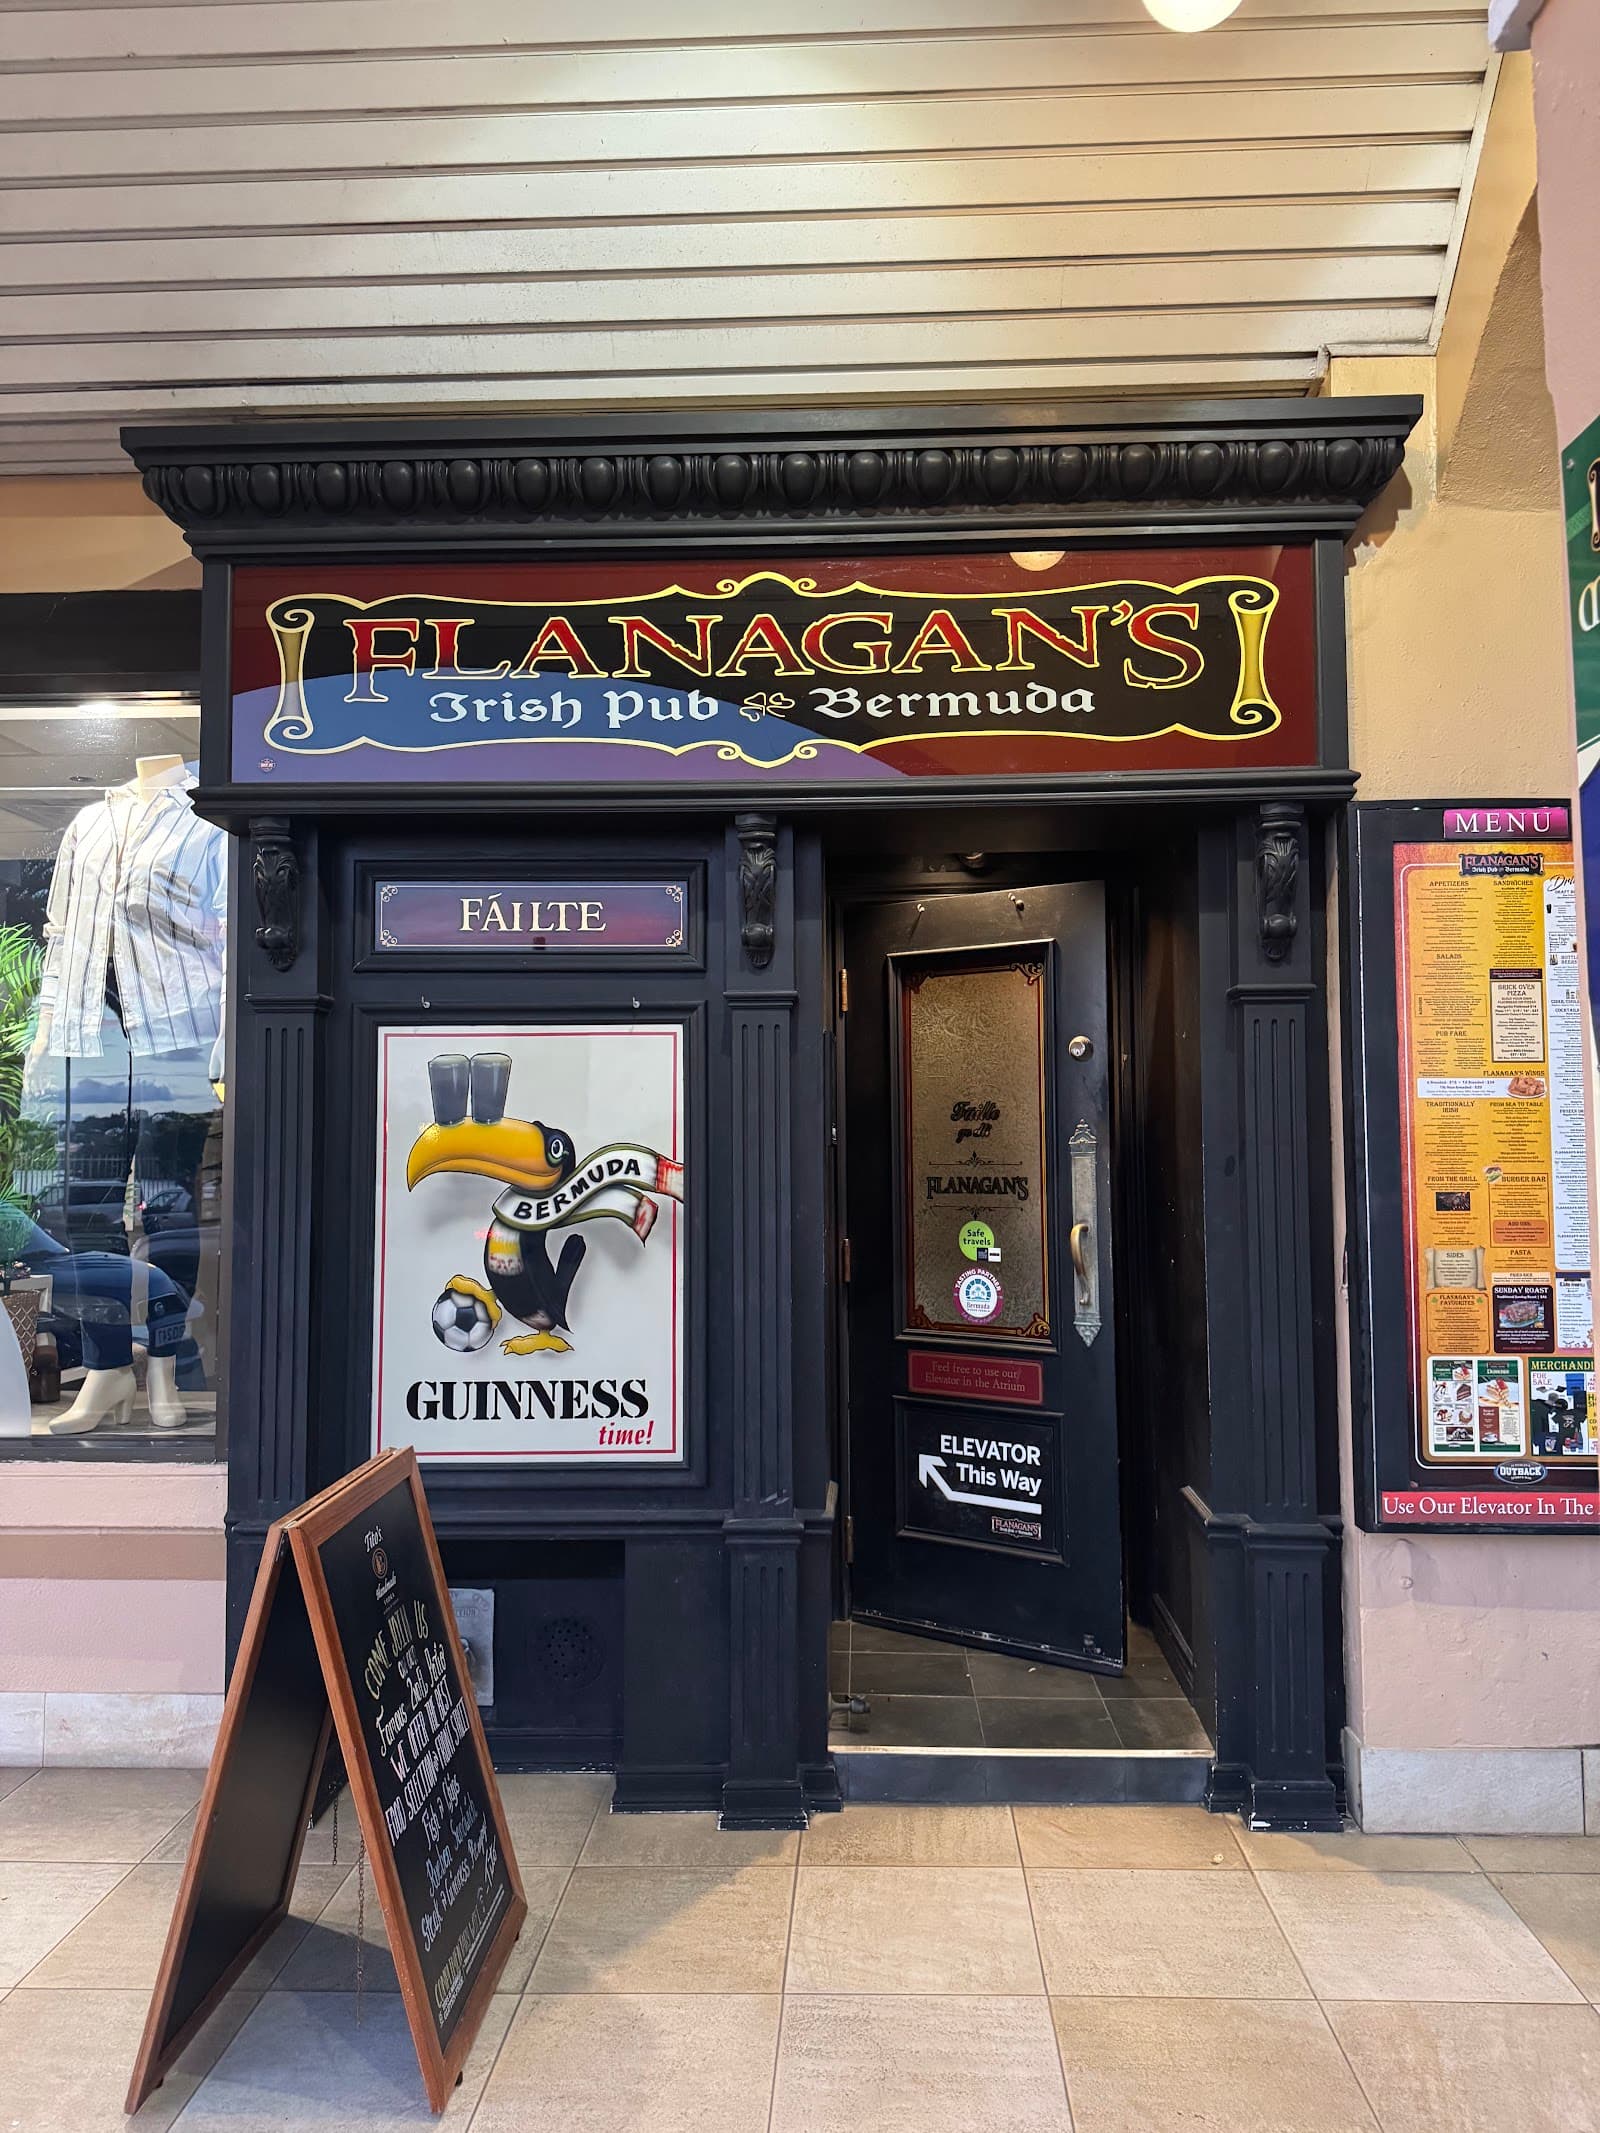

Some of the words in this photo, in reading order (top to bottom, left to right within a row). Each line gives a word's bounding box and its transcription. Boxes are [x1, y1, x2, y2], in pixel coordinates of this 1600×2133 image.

[343, 603, 1204, 703] FLANAGAN'S
[430, 690, 582, 730] Irish
[603, 689, 719, 729] Pub
[809, 682, 1096, 719] Bermuda
[1455, 812, 1552, 833] MENU
[1464, 854, 1539, 869] FLANAGAN'S
[459, 892, 608, 932] FÁILTE
[513, 1158, 642, 1221] BERMUDA
[926, 1176, 1029, 1200] FLANAGAN'S
[963, 1237, 991, 1246] travels
[967, 1229, 985, 1237] Safe
[955, 1269, 977, 1289] TASTING
[977, 1268, 1002, 1291] PARTNER
[1494, 1286, 1524, 1294] SUNDAY
[925, 1372, 959, 1385] Elevator
[975, 1377, 990, 1388] the
[992, 1379, 1026, 1393] Atrium
[932, 1361, 950, 1372] Feel
[953, 1362, 970, 1374] free
[972, 1367, 982, 1376] to
[984, 1368, 1000, 1377] use
[406, 1379, 650, 1420] GUINNESS
[599, 1420, 655, 1446] time!
[940, 1434, 1041, 1466] ELEVATOR
[956, 1462, 997, 1486] This
[1000, 1469, 1042, 1497] Way
[1500, 1466, 1542, 1476] OUTBACK
[1383, 1498, 1415, 1514] Use
[1419, 1497, 1456, 1514] Our
[1460, 1497, 1532, 1515] Elevator
[1537, 1497, 1555, 1515] In
[1560, 1497, 1594, 1515] The
[364, 1525, 383, 1552] Tito's
[995, 1519, 1038, 1535] FLANAGAN'S
[364, 1630, 392, 1700] COME
[413, 1600, 429, 1640] US
[375, 1705, 408, 1757] Famous
[389, 1740, 411, 1783] WE
[407, 1710, 430, 1759] OFFER
[424, 1695, 440, 1734] THE
[434, 1674, 453, 1721] BEST
[385, 1803, 407, 1847] FOOD
[404, 1750, 437, 1821] SELECTION
[434, 1714, 455, 1769] FRONT
[422, 1803, 441, 1851] Fish
[442, 1772, 460, 1813] Chips
[421, 1897, 444, 1952] Steak
[444, 1857, 470, 1906] Guinness
